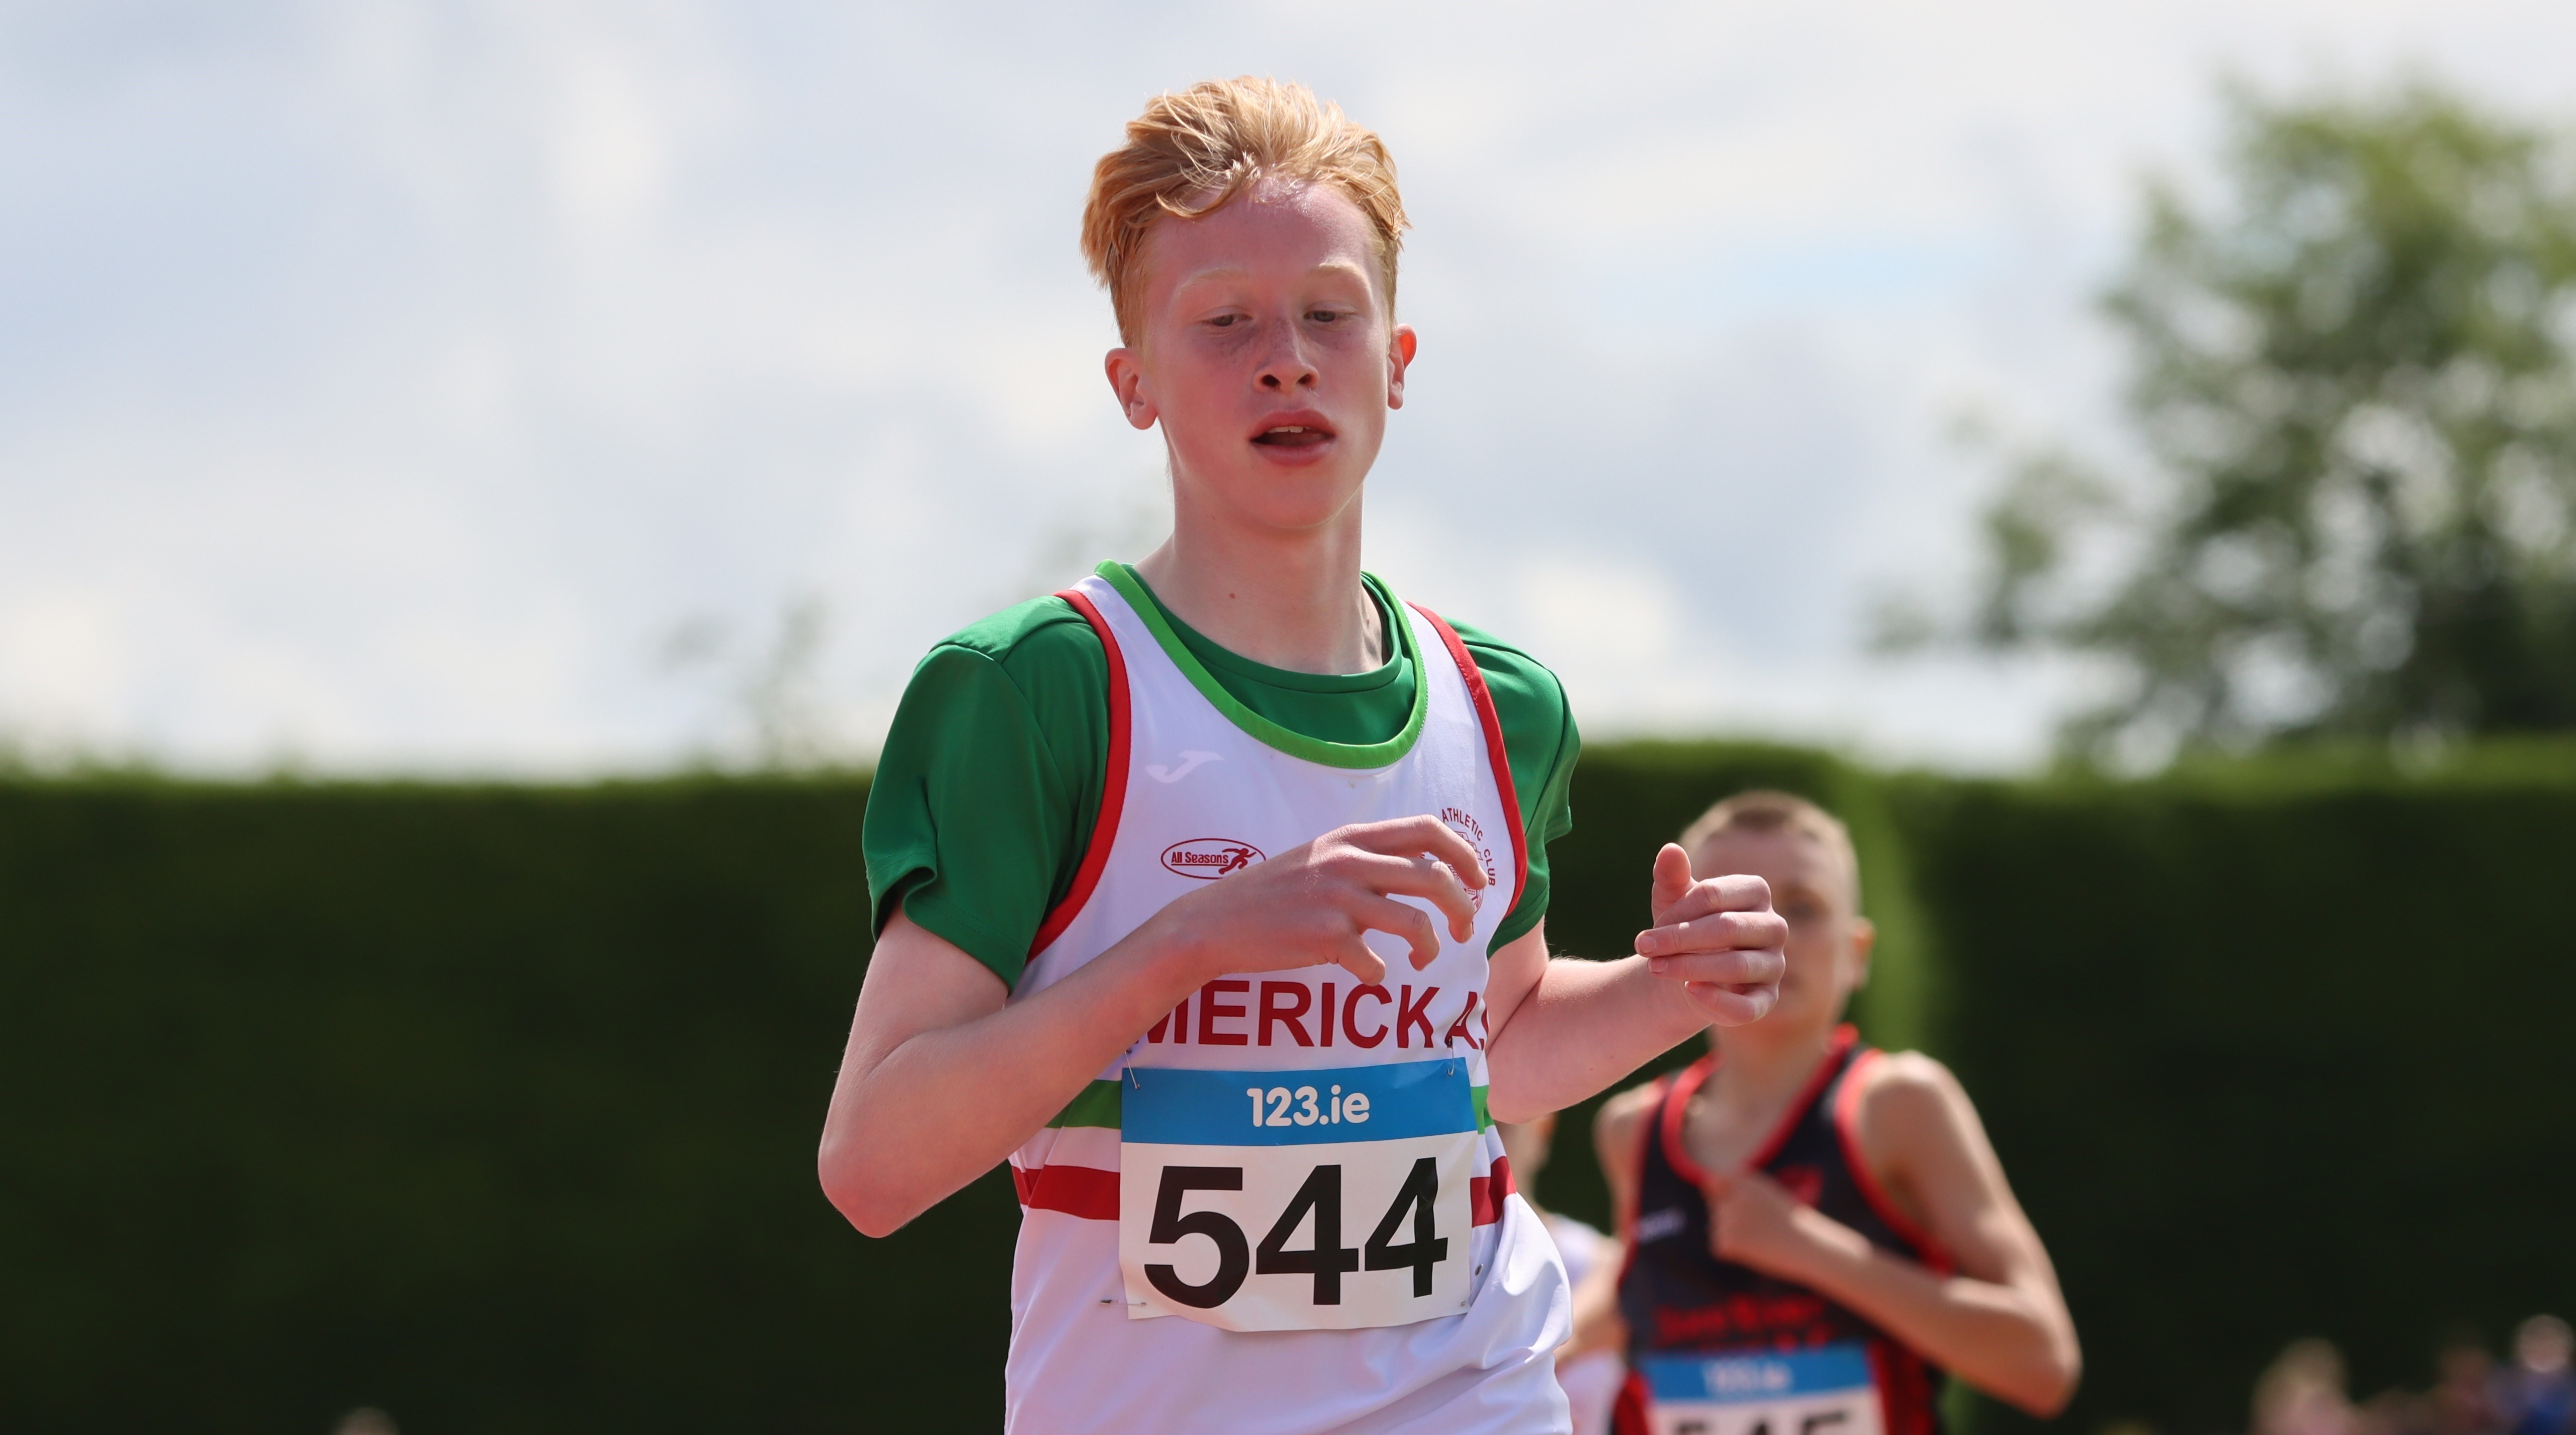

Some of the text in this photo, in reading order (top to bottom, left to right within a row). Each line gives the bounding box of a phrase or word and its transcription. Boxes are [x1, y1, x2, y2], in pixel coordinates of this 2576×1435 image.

[1171, 851, 1229, 864] All Seasons
[1441, 807, 1496, 886] ATHLETIC CLUB
[1246, 1084, 1370, 1127] 123.ie
[1144, 1156, 1448, 1309] 544
